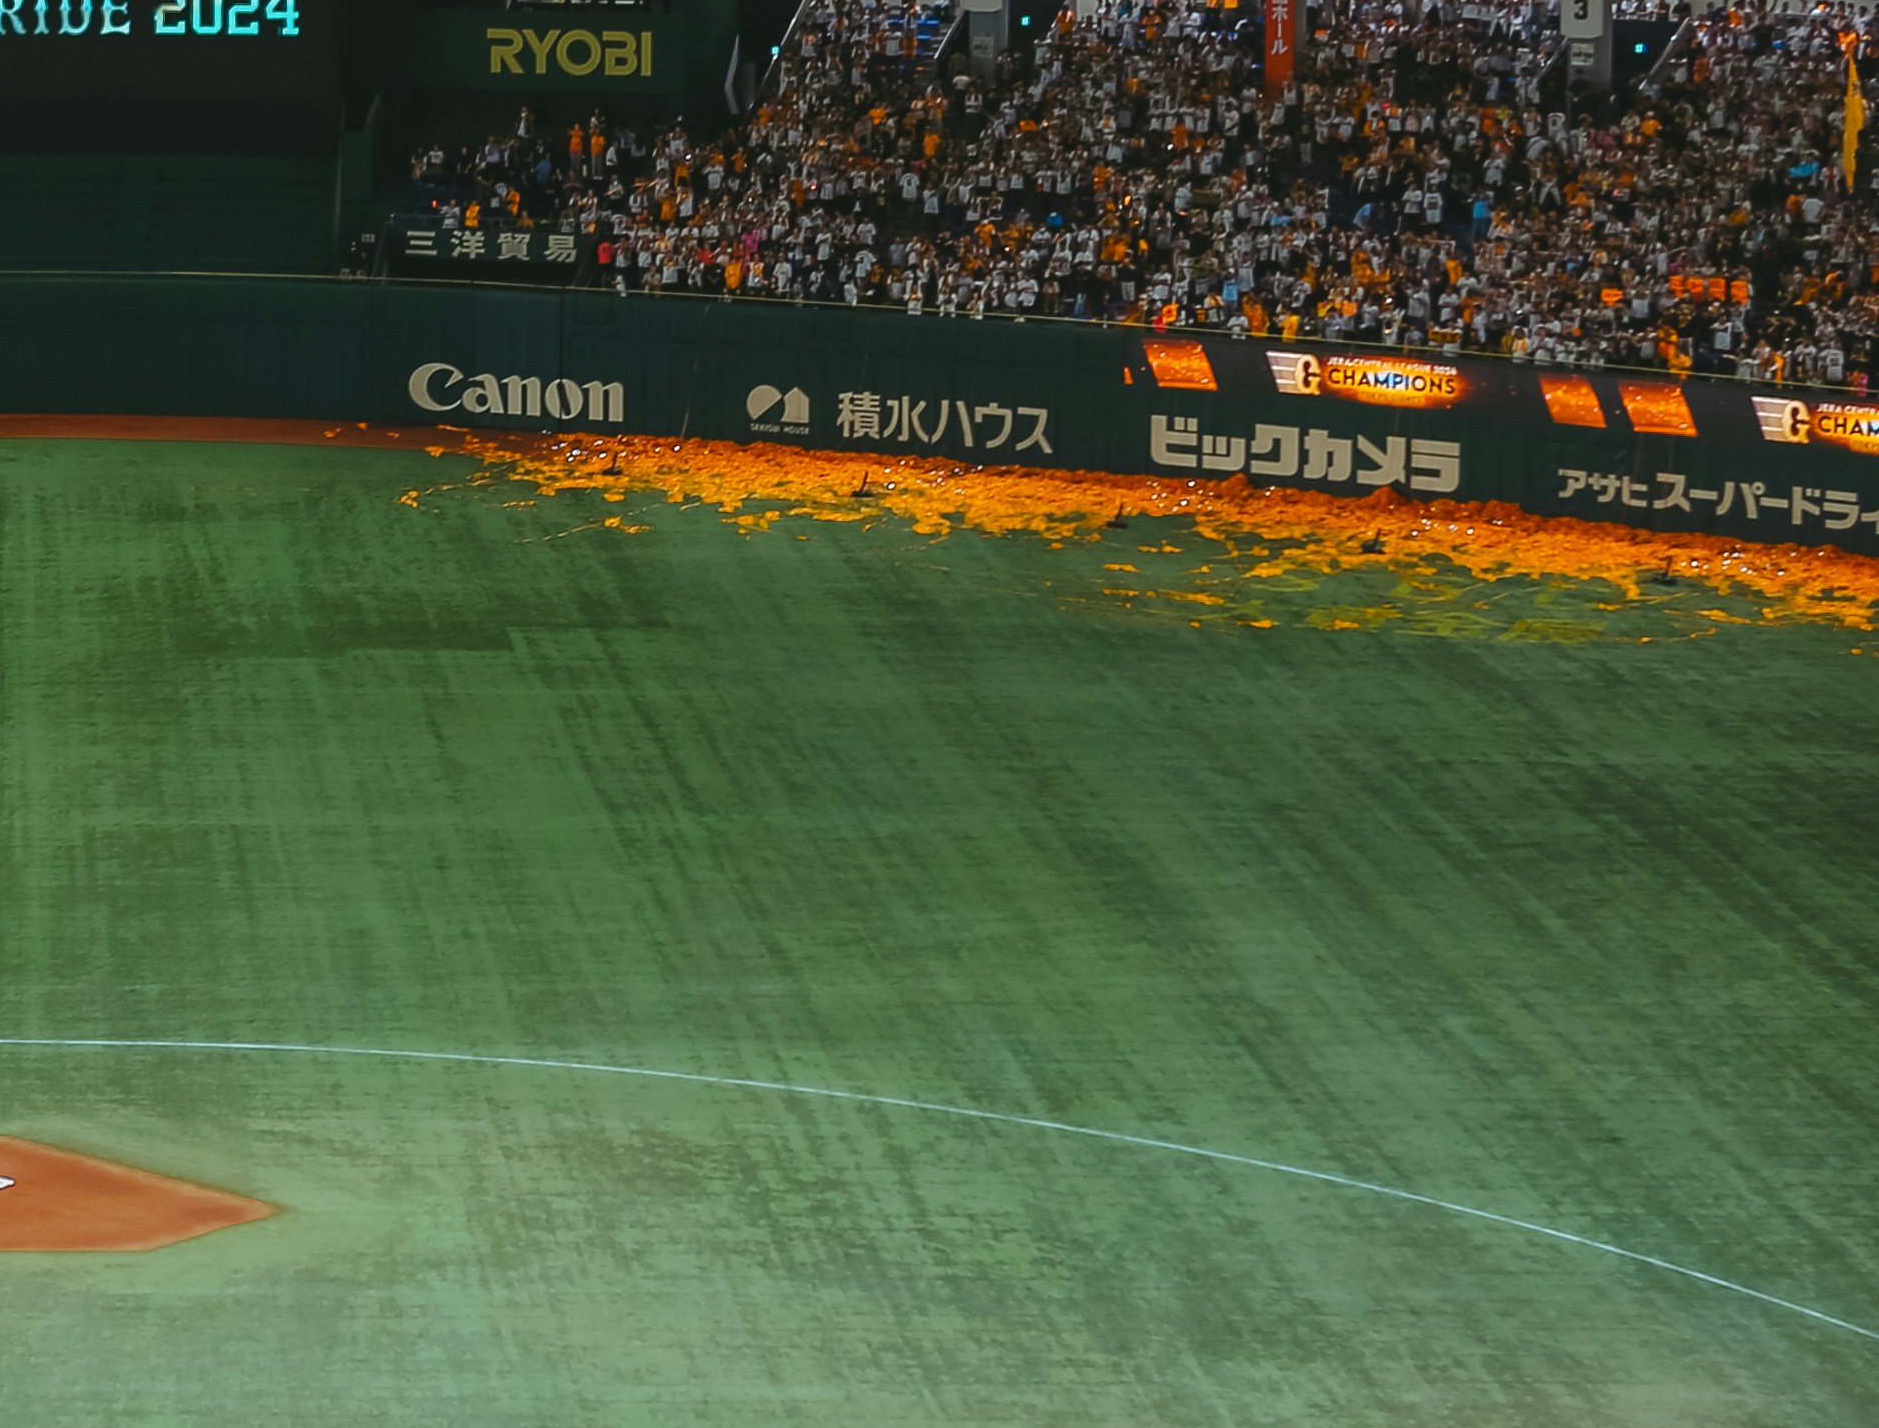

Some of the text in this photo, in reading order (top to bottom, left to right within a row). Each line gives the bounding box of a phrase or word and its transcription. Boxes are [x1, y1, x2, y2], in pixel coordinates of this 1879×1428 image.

[486, 27, 654, 77] RYOBI
[404, 229, 578, 264] 三洋貿易
[407, 361, 625, 424] Canon
[1327, 368, 1456, 395] CHAMPIONS
[783, 425, 810, 435] HOUSE
[836, 391, 1054, 455] 積水ハウス
[1148, 413, 1461, 494] ビックカメラ
